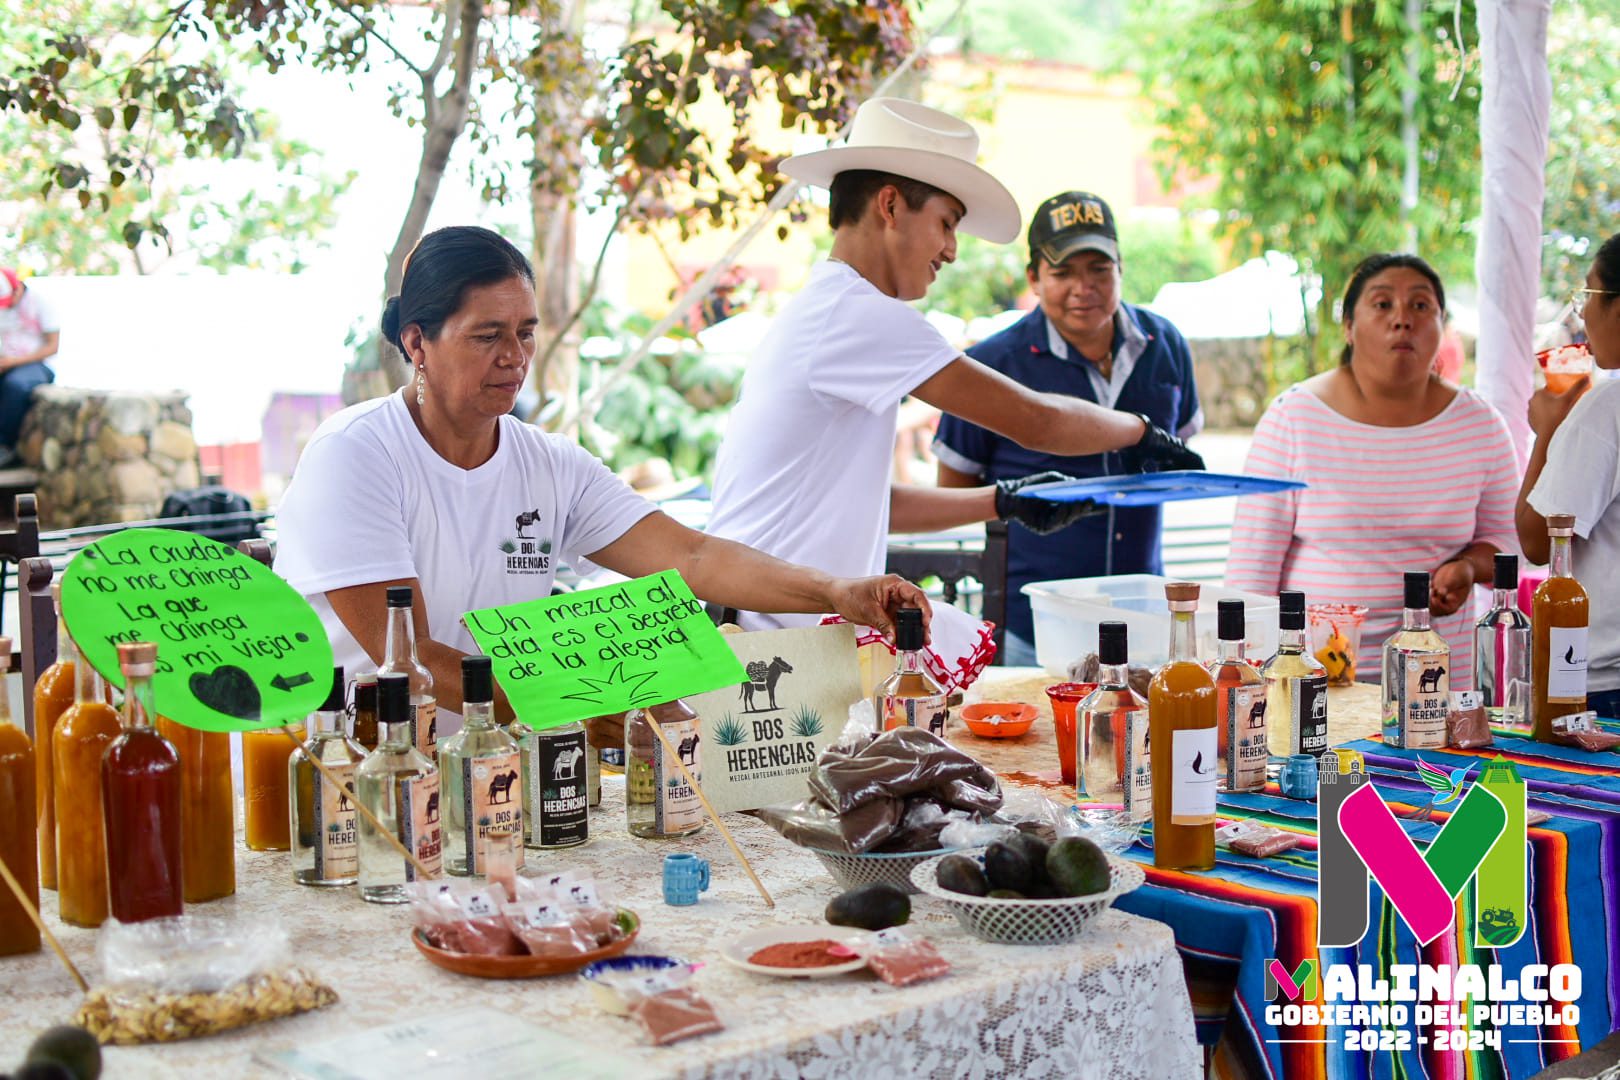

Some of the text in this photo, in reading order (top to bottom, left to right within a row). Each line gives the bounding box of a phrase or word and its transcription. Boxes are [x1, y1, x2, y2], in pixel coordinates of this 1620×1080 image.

[1049, 201, 1104, 232] TEXAS
[93, 542, 141, 566] La
[77, 575, 118, 594] no
[124, 573, 166, 590] me
[117, 596, 208, 622] La que
[470, 576, 677, 637] Un mezcal al
[491, 634, 542, 660] día
[552, 626, 586, 648] es
[595, 616, 623, 639] el
[181, 644, 223, 667] mi
[508, 626, 689, 681] de la alegría
[1424, 699, 1438, 709] DOS
[752, 717, 784, 742] DOS
[1254, 734, 1264, 746] DOS
[726, 741, 816, 773] HERENCIAS
[729, 773, 751, 783] MEZCAL
[752, 769, 784, 780] ARTESANAL
[801, 765, 812, 774] AGA
[560, 785, 576, 799] DOS
[544, 795, 586, 813] HERENCIAS
[495, 811, 511, 824] DOS
